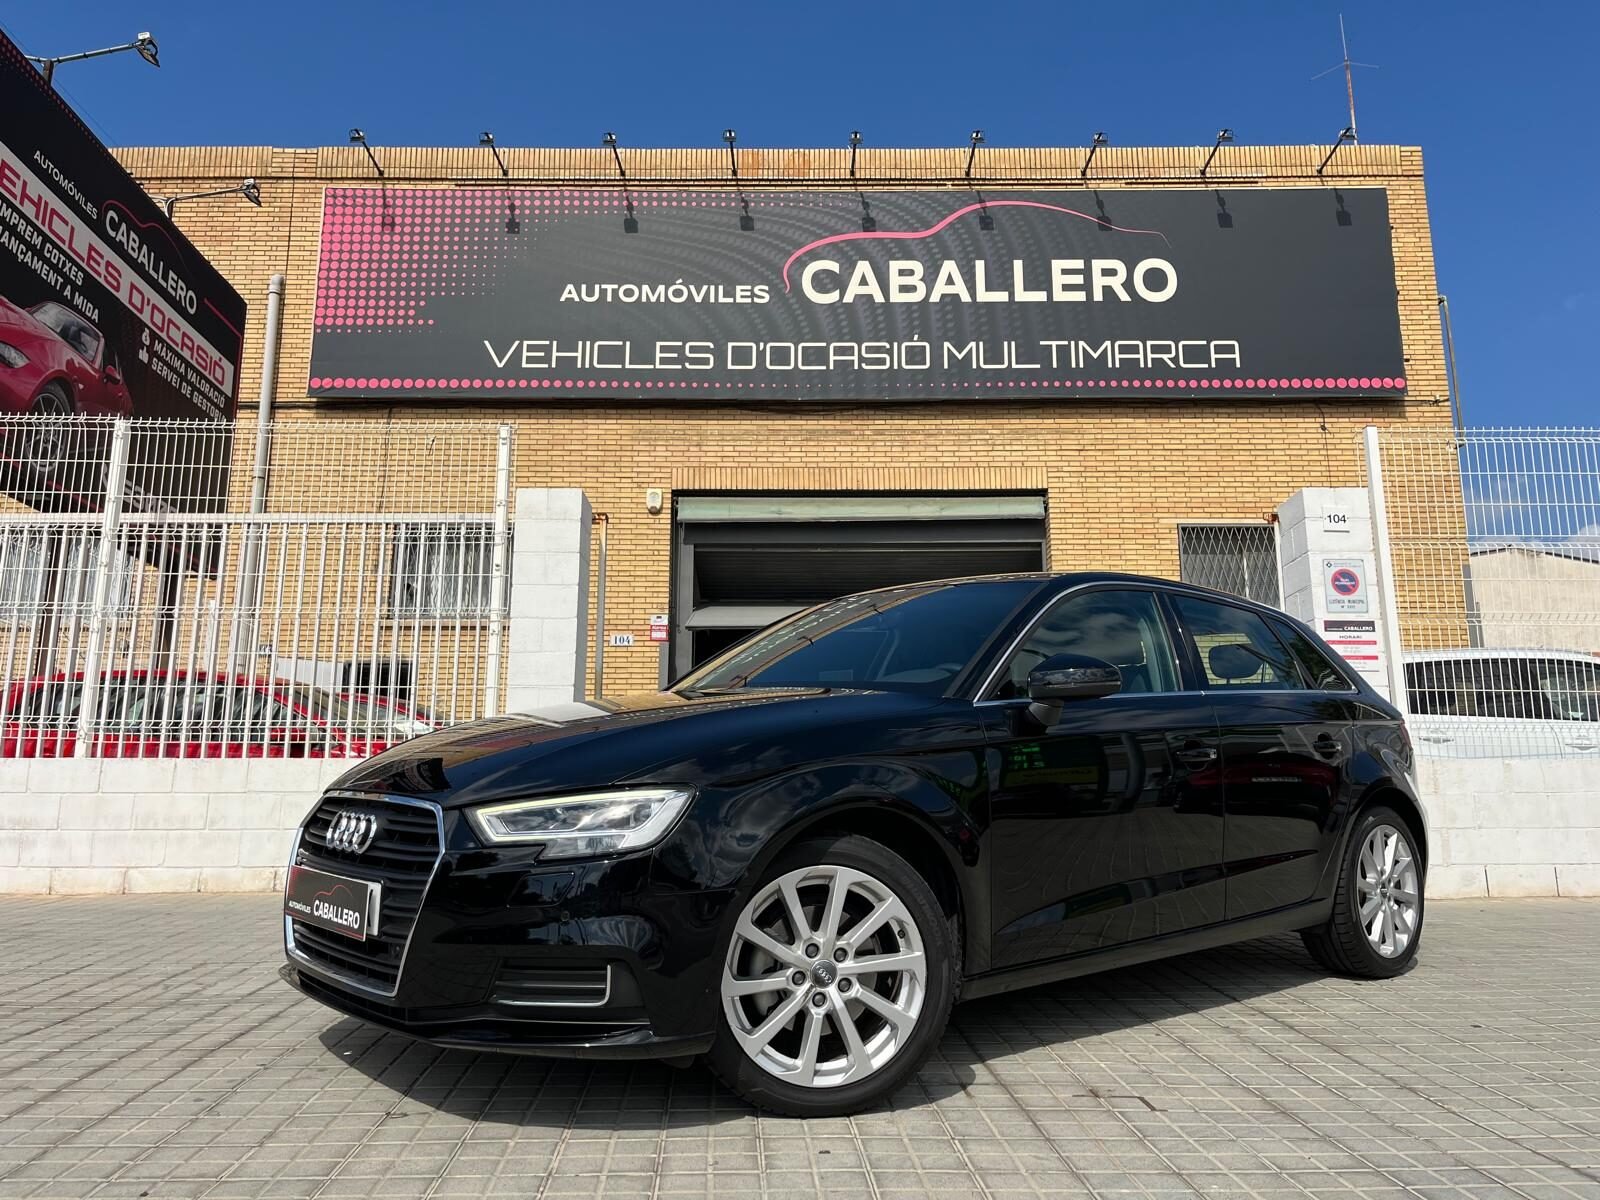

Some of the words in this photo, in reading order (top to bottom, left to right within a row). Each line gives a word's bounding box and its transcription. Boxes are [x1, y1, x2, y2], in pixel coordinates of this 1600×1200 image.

[0, 199, 42, 250] MPREM
[44, 243, 84, 286] COTXES
[33, 150, 98, 220] AUTOMÓVILES
[105, 210, 197, 315] CABALLERO
[559, 278, 770, 303] AUTOMÓVILES
[801, 257, 1178, 304] CABALLERO
[63, 284, 72, 300] A
[73, 291, 100, 323] MIDA
[128, 281, 225, 387] D'OCASIÓ
[484, 340, 714, 370] VEHICLES
[727, 335, 930, 370] D'OCASIÓ
[151, 358, 180, 389] SERVEI
[181, 381, 192, 398] DE
[187, 367, 225, 408] VALORACIÓ
[1327, 513, 1347, 524] 104
[614, 635, 630, 644] 104
[313, 900, 360, 929] CABALLERO
